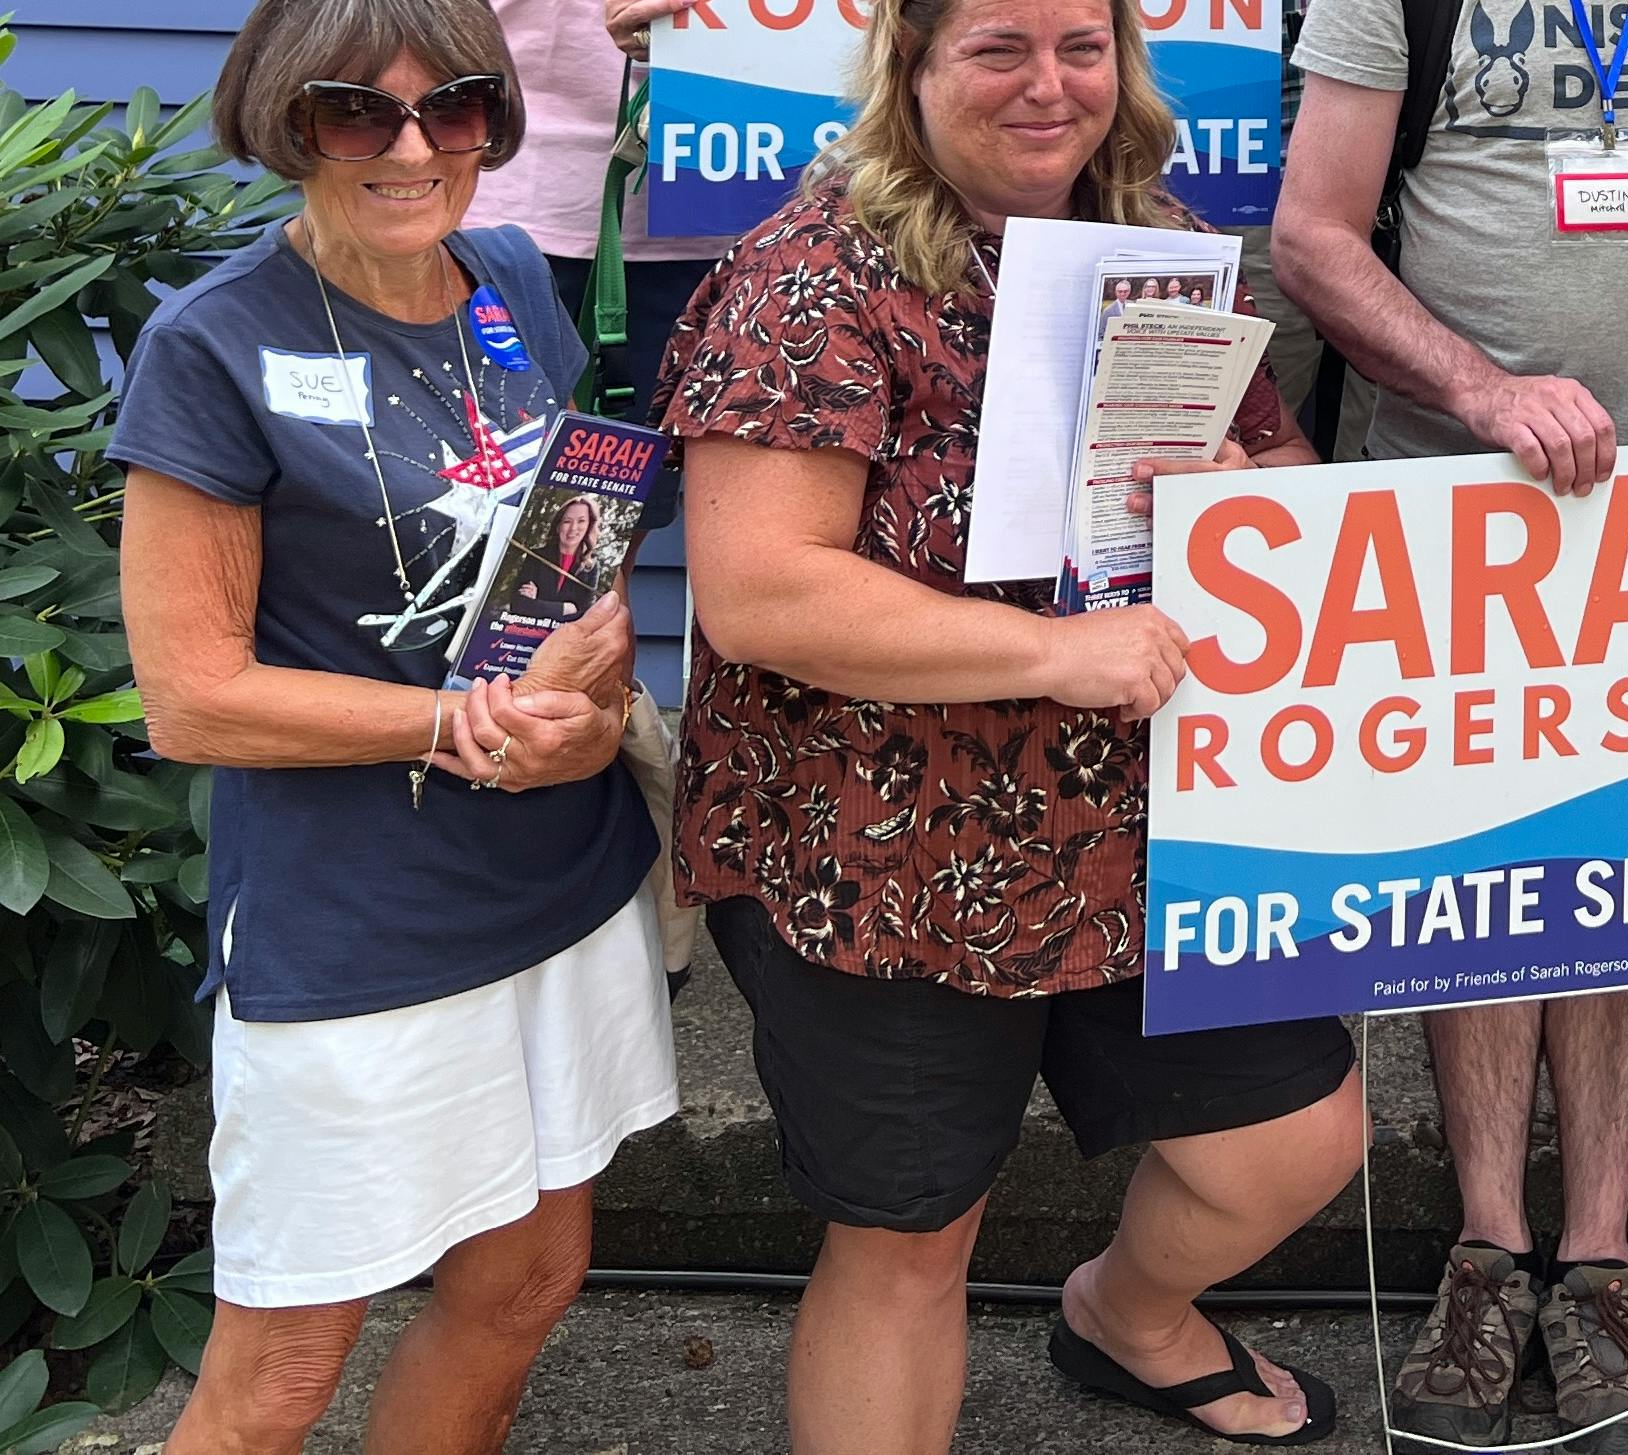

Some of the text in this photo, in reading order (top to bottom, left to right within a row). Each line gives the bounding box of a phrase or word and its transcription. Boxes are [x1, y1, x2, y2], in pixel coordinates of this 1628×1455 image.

[663, 122, 785, 182] FOR
[289, 371, 344, 392] SUE
[564, 428, 655, 470] SARAH
[550, 471, 637, 495] FOR STATE SENATE
[556, 455, 643, 482] ROGERSON
[1164, 891, 1300, 972] FOR
[1329, 866, 1545, 953] STATE
[1374, 981, 1405, 995] Paid
[1410, 977, 1429, 992] for
[1434, 976, 1450, 992] by
[1456, 968, 1507, 987] Friends
[1512, 966, 1525, 981] of
[1530, 962, 1570, 980] Sarah
